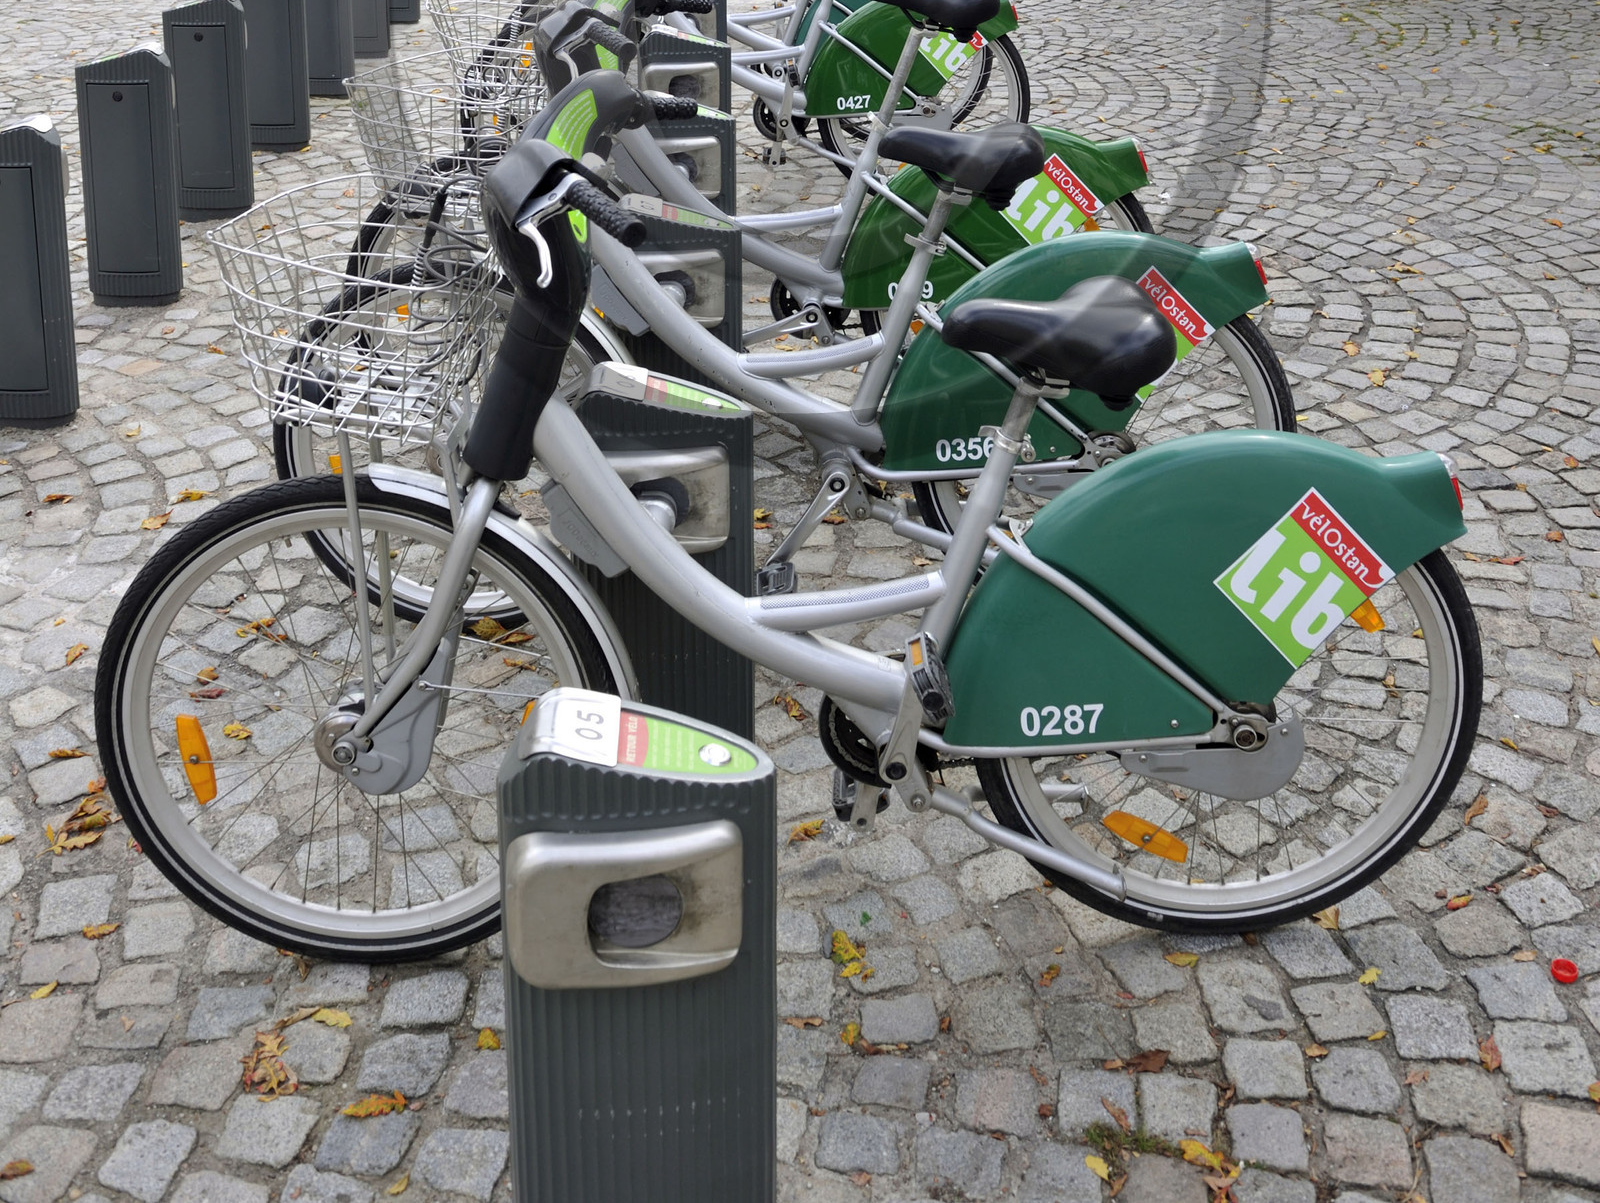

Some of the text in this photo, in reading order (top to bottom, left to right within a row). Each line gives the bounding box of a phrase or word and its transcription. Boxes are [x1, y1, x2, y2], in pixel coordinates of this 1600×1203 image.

[837, 95, 871, 110] 0427
[1048, 161, 1089, 212] vélOstan
[1144, 275, 1198, 336] vélOstan
[1302, 502, 1370, 583] vélOstan
[1231, 528, 1345, 649] lib
[574, 710, 604, 741] 05
[625, 716, 638, 764] RETOUR VÉLO
[1020, 703, 1105, 737] 0287
